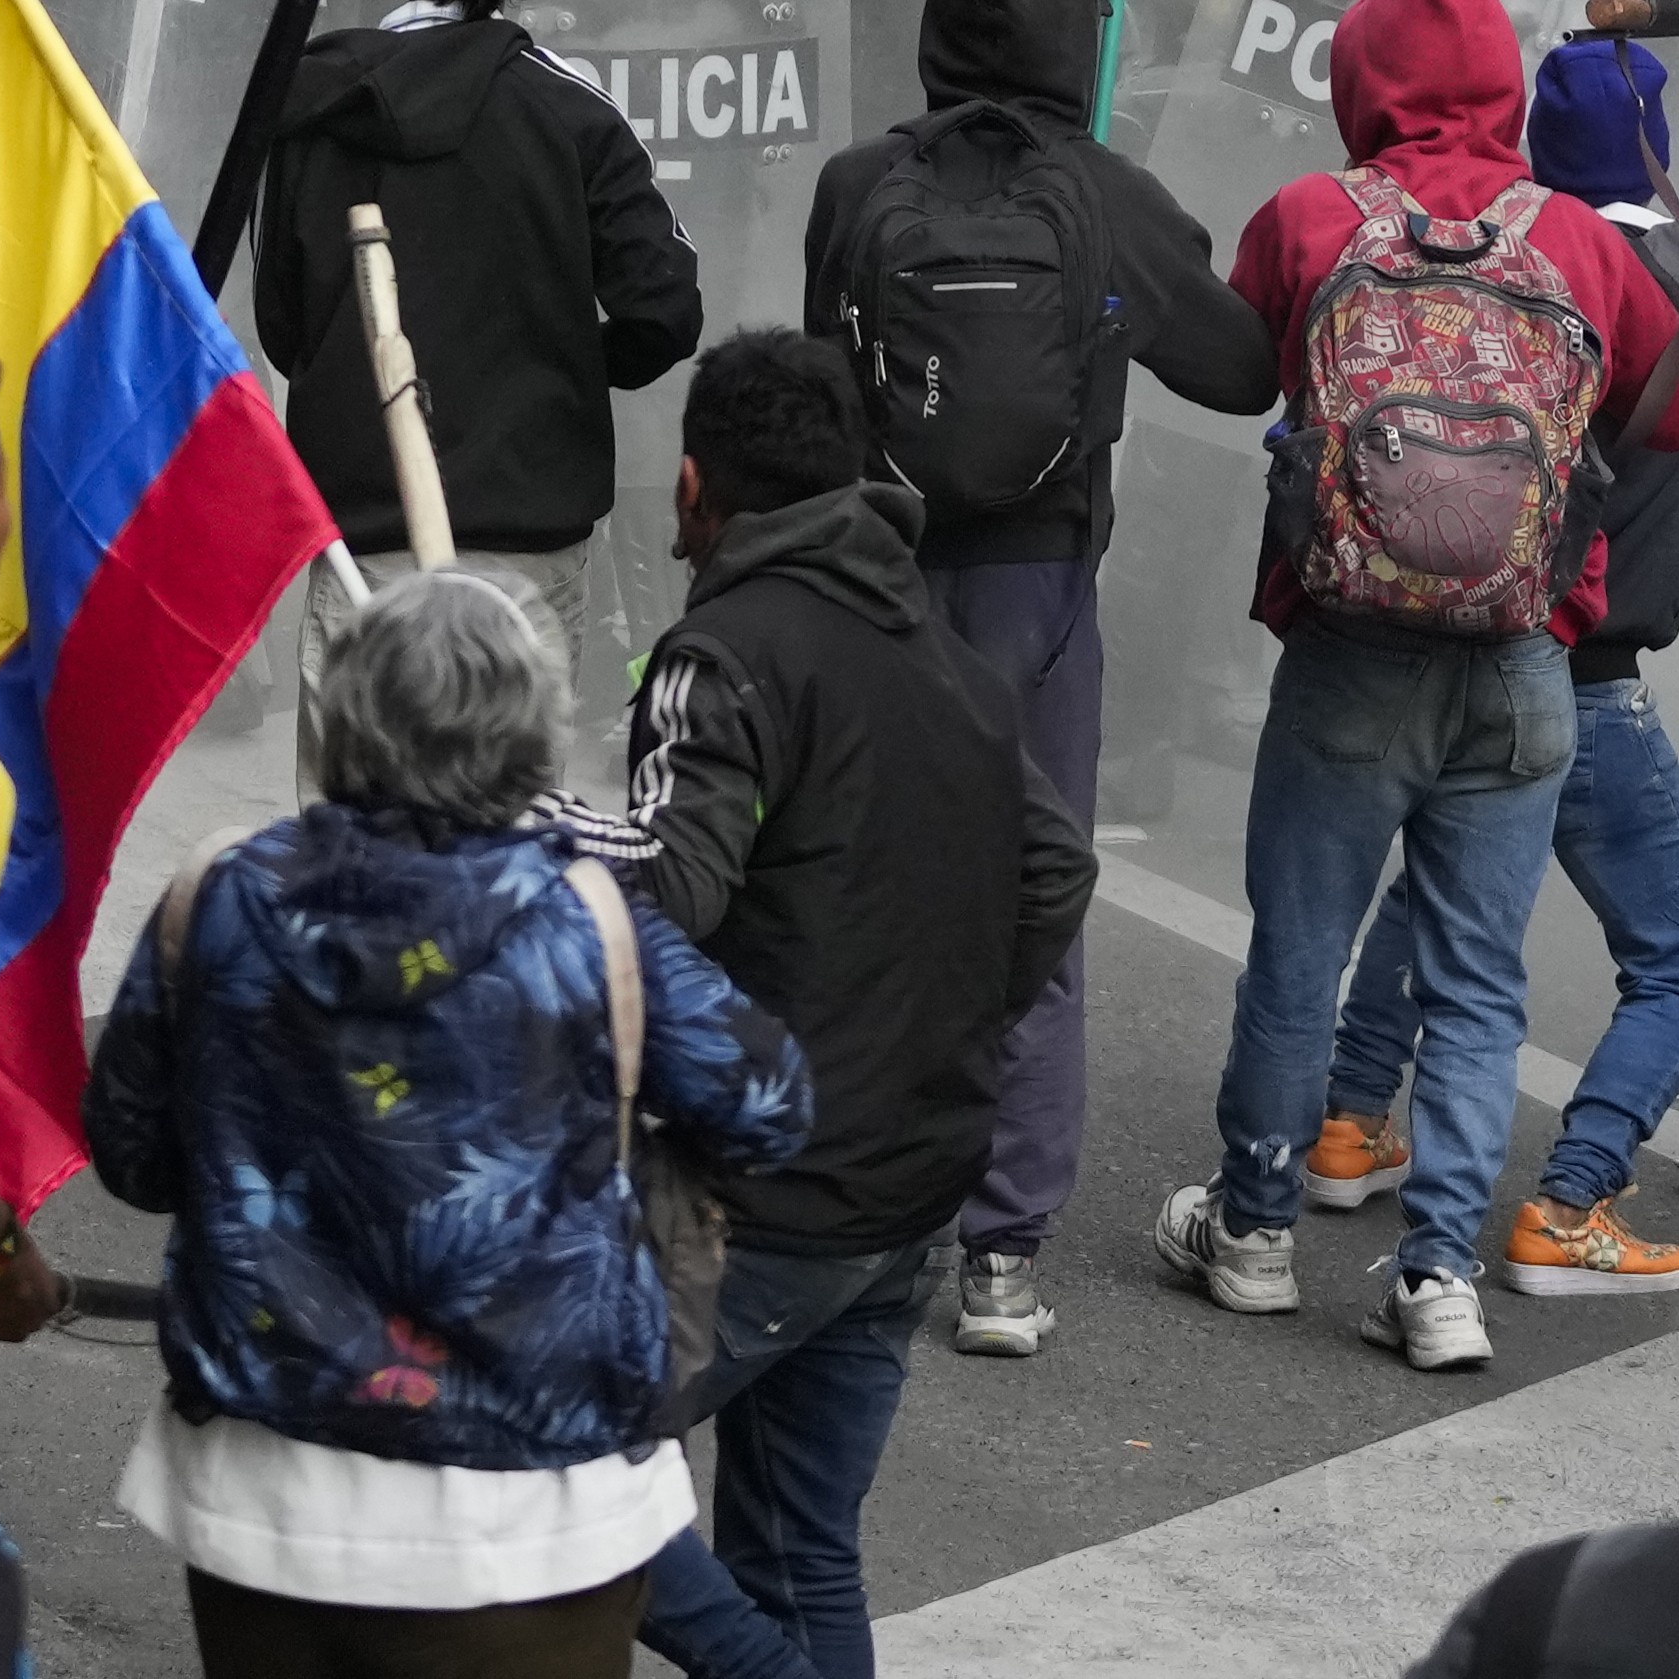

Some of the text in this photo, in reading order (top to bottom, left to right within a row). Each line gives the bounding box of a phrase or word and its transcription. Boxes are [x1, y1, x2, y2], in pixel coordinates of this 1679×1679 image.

[1341, 355, 1387, 376] RACING
[923, 354, 940, 419] TOTTO
[1465, 565, 1514, 604] RACING
